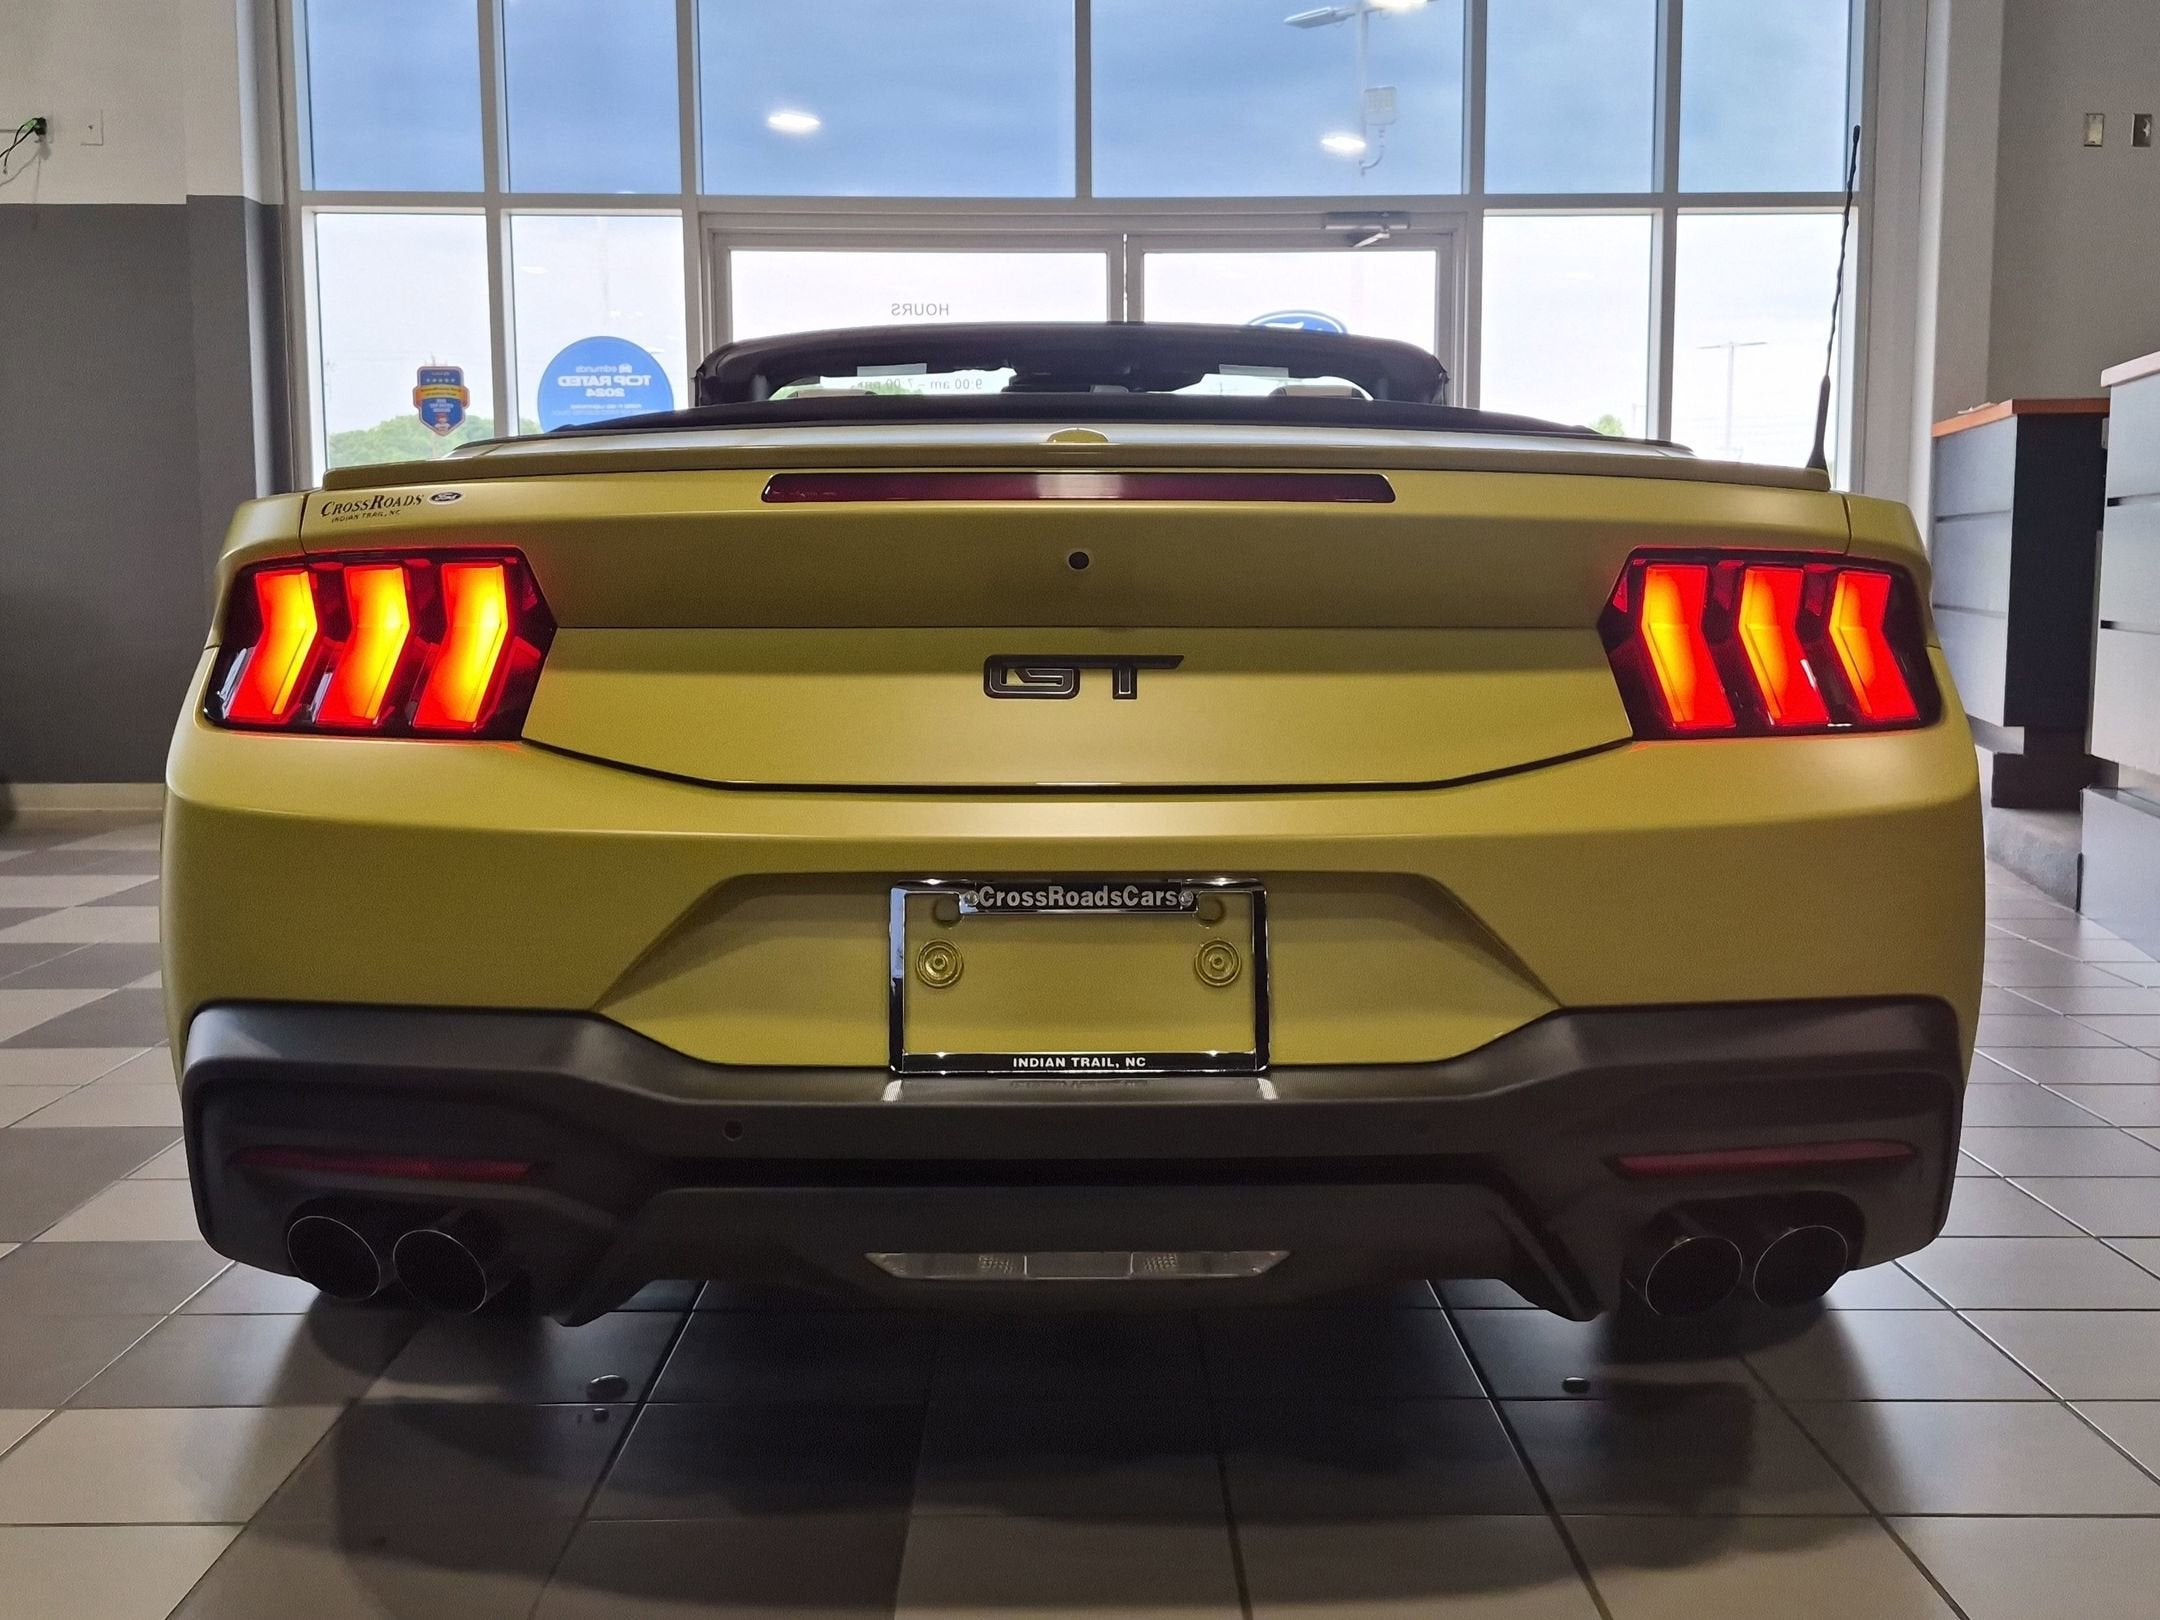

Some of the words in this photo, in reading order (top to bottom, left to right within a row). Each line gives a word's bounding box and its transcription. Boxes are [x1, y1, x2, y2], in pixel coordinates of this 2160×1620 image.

[331, 514, 359, 523] INDIAN
[983, 654, 1184, 699] GT
[978, 885, 1180, 907] CrossRoadsCars
[1013, 1057, 1066, 1068] INDIAN
[1070, 1057, 1120, 1069] TRAIL,
[1125, 1057, 1146, 1067] NC
